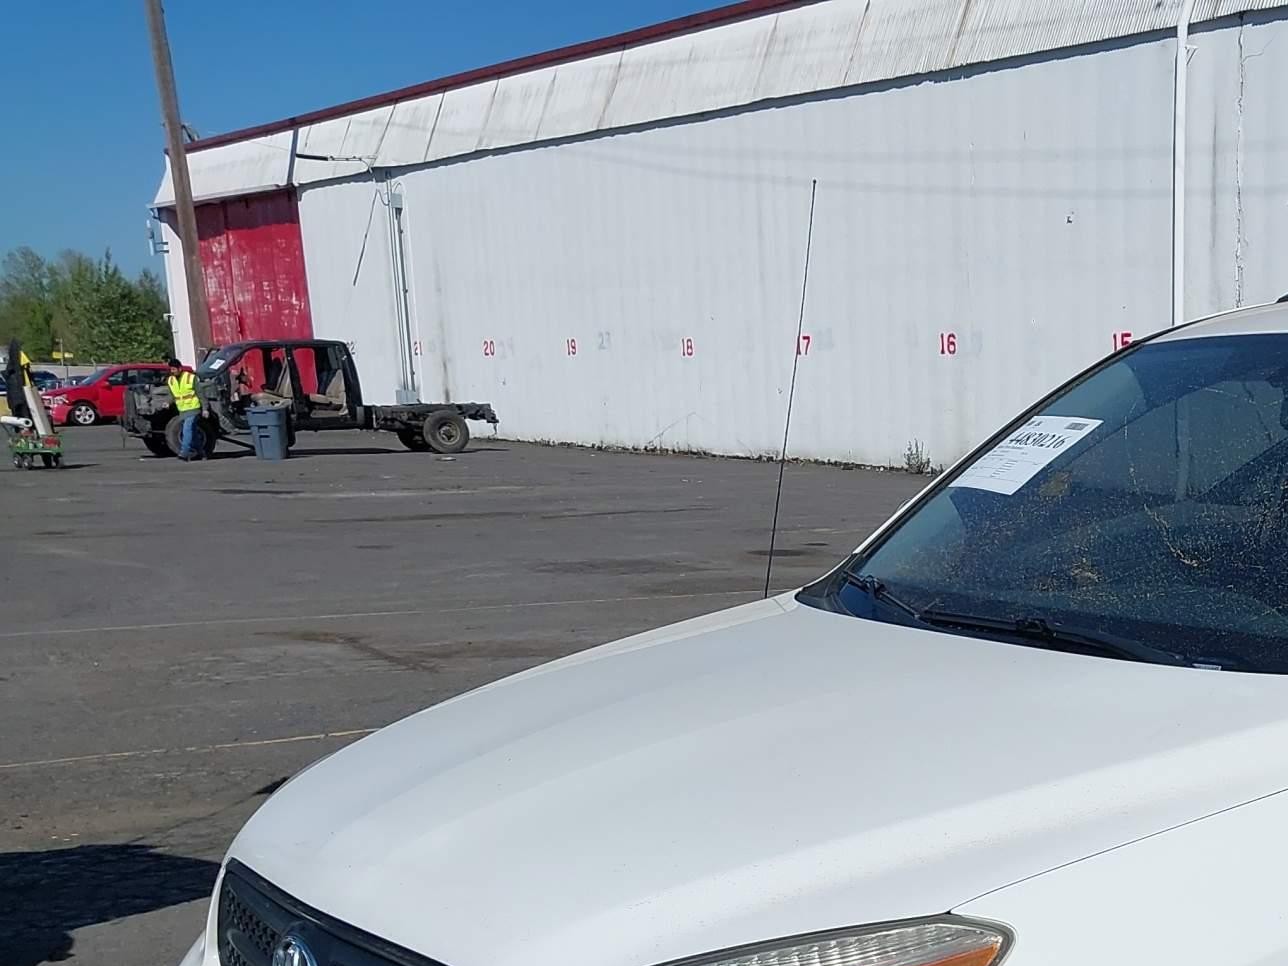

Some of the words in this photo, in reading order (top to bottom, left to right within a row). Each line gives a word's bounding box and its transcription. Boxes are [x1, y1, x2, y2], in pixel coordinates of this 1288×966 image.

[413, 341, 423, 356] 21
[483, 340, 495, 356] 20
[566, 338, 577, 356] 19
[681, 338, 694, 356] 18
[796, 336, 811, 355] 17
[939, 333, 957, 355] 16
[1113, 332, 1132, 352] 15
